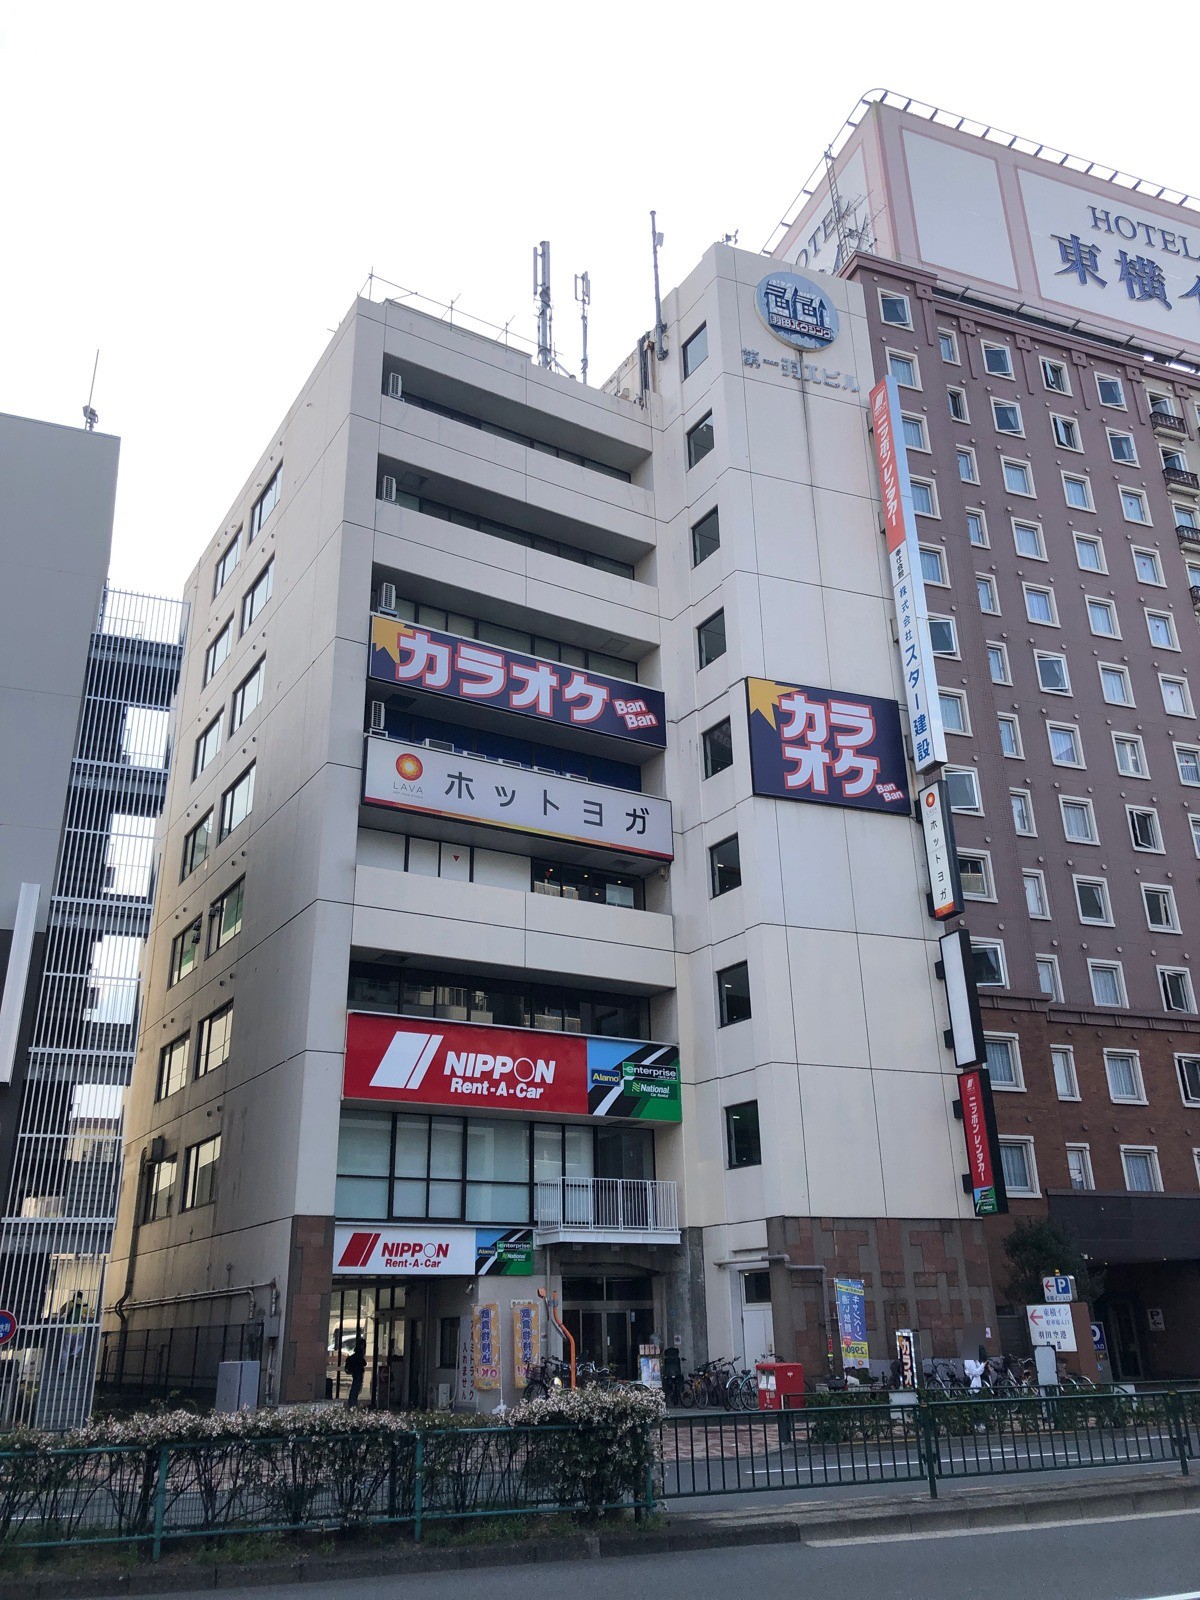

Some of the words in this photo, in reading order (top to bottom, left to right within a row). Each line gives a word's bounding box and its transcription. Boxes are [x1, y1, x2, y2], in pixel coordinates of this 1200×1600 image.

[1087, 204, 1200, 262] HOTEL
[396, 630, 610, 724] カラオケ
[614, 699, 647, 718] Ban
[624, 713, 658, 731] Ban
[779, 691, 876, 750] カラ
[782, 743, 881, 798] オケ
[393, 781, 424, 795] LAVA
[875, 783, 896, 794] Ban
[882, 789, 904, 802] Ban
[444, 771, 650, 835] ホットヨガ
[929, 818, 948, 900] ホットヨガ
[443, 1051, 556, 1084] NIPPON
[624, 1065, 676, 1078] enterprise
[592, 1072, 619, 1083] Alamo
[450, 1077, 543, 1100] Rent-A-Car
[640, 1083, 670, 1095] National
[381, 1242, 450, 1259] NIPPON
[385, 1258, 442, 1269] Rent-A-Car
[1057, 1278, 1066, 1293] P
